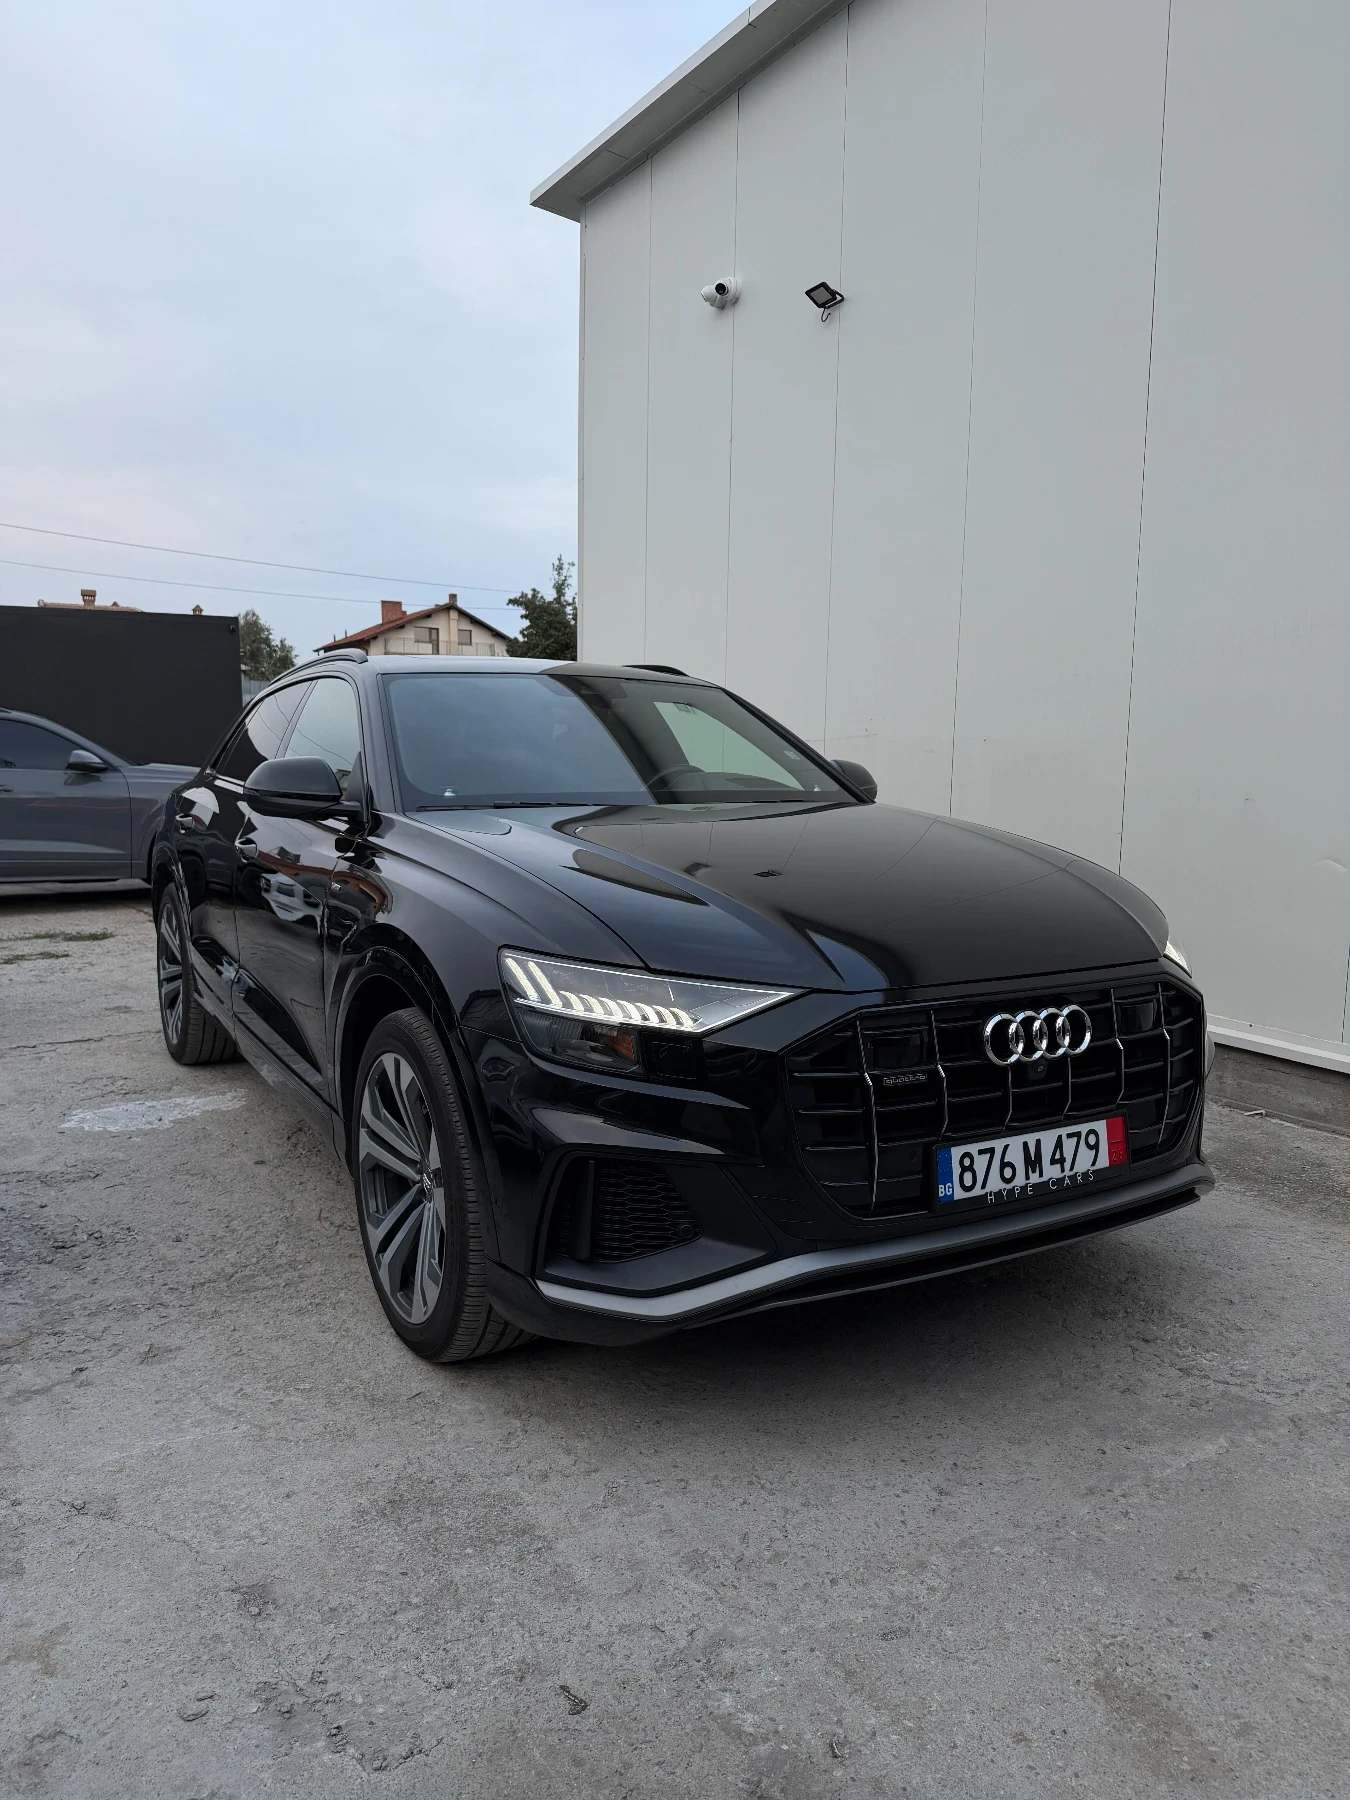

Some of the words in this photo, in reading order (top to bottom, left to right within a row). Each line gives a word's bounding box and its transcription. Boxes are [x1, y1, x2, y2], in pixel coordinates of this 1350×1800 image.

[938, 1182, 953, 1197] BG
[987, 1183, 1034, 1204] HYPE
[1049, 1170, 1094, 1190] CARS
